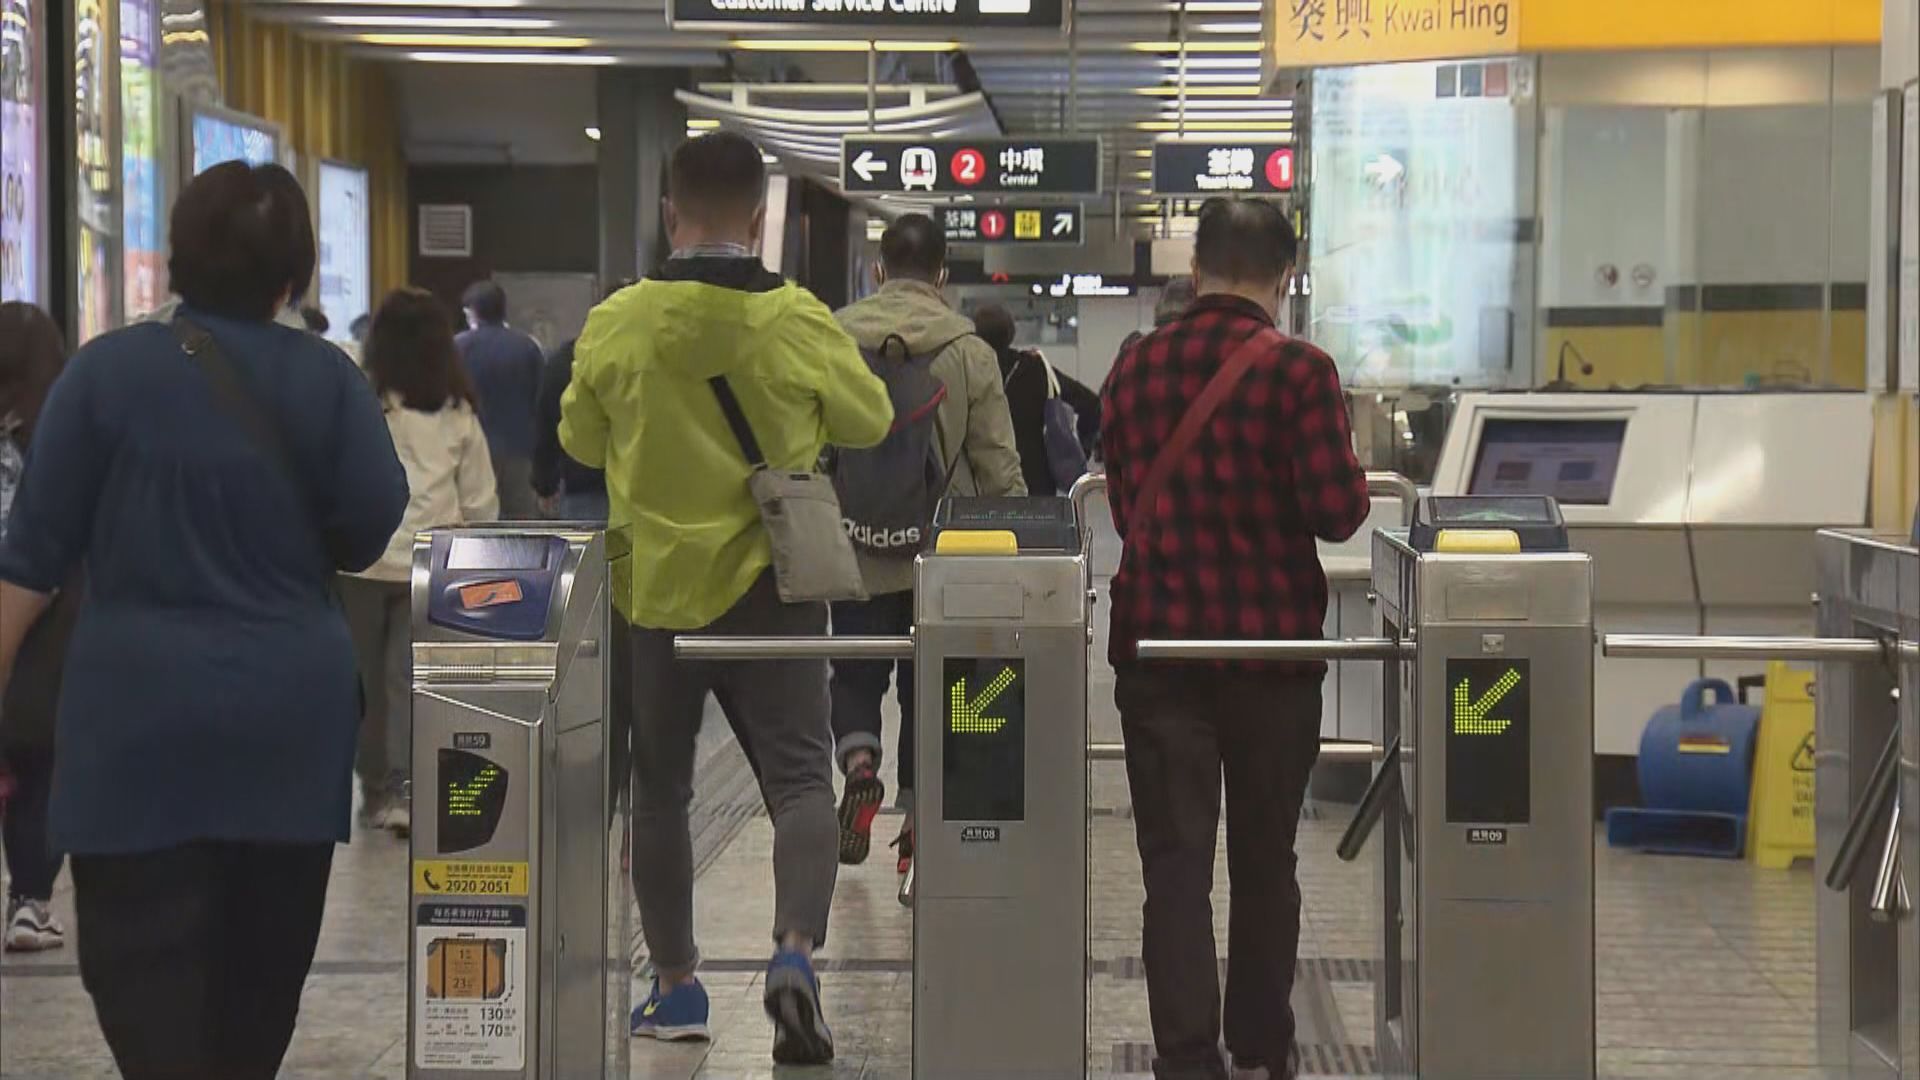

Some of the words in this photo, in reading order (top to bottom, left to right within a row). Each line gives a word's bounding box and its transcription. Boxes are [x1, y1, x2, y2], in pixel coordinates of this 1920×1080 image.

[711, 0, 806, 11] Customer
[811, 0, 884, 12] Service
[889, 0, 957, 14] Centre
[1384, 0, 1441, 35] Kwai
[1450, 0, 1508, 36] Hing
[960, 153, 977, 180] 2
[1000, 147, 1044, 173] 中環
[1277, 155, 1291, 182] 1
[1000, 173, 1039, 186] Central
[988, 214, 997, 236] 1
[480, 1007, 504, 1021] 130
[480, 1023, 504, 1038] 170
